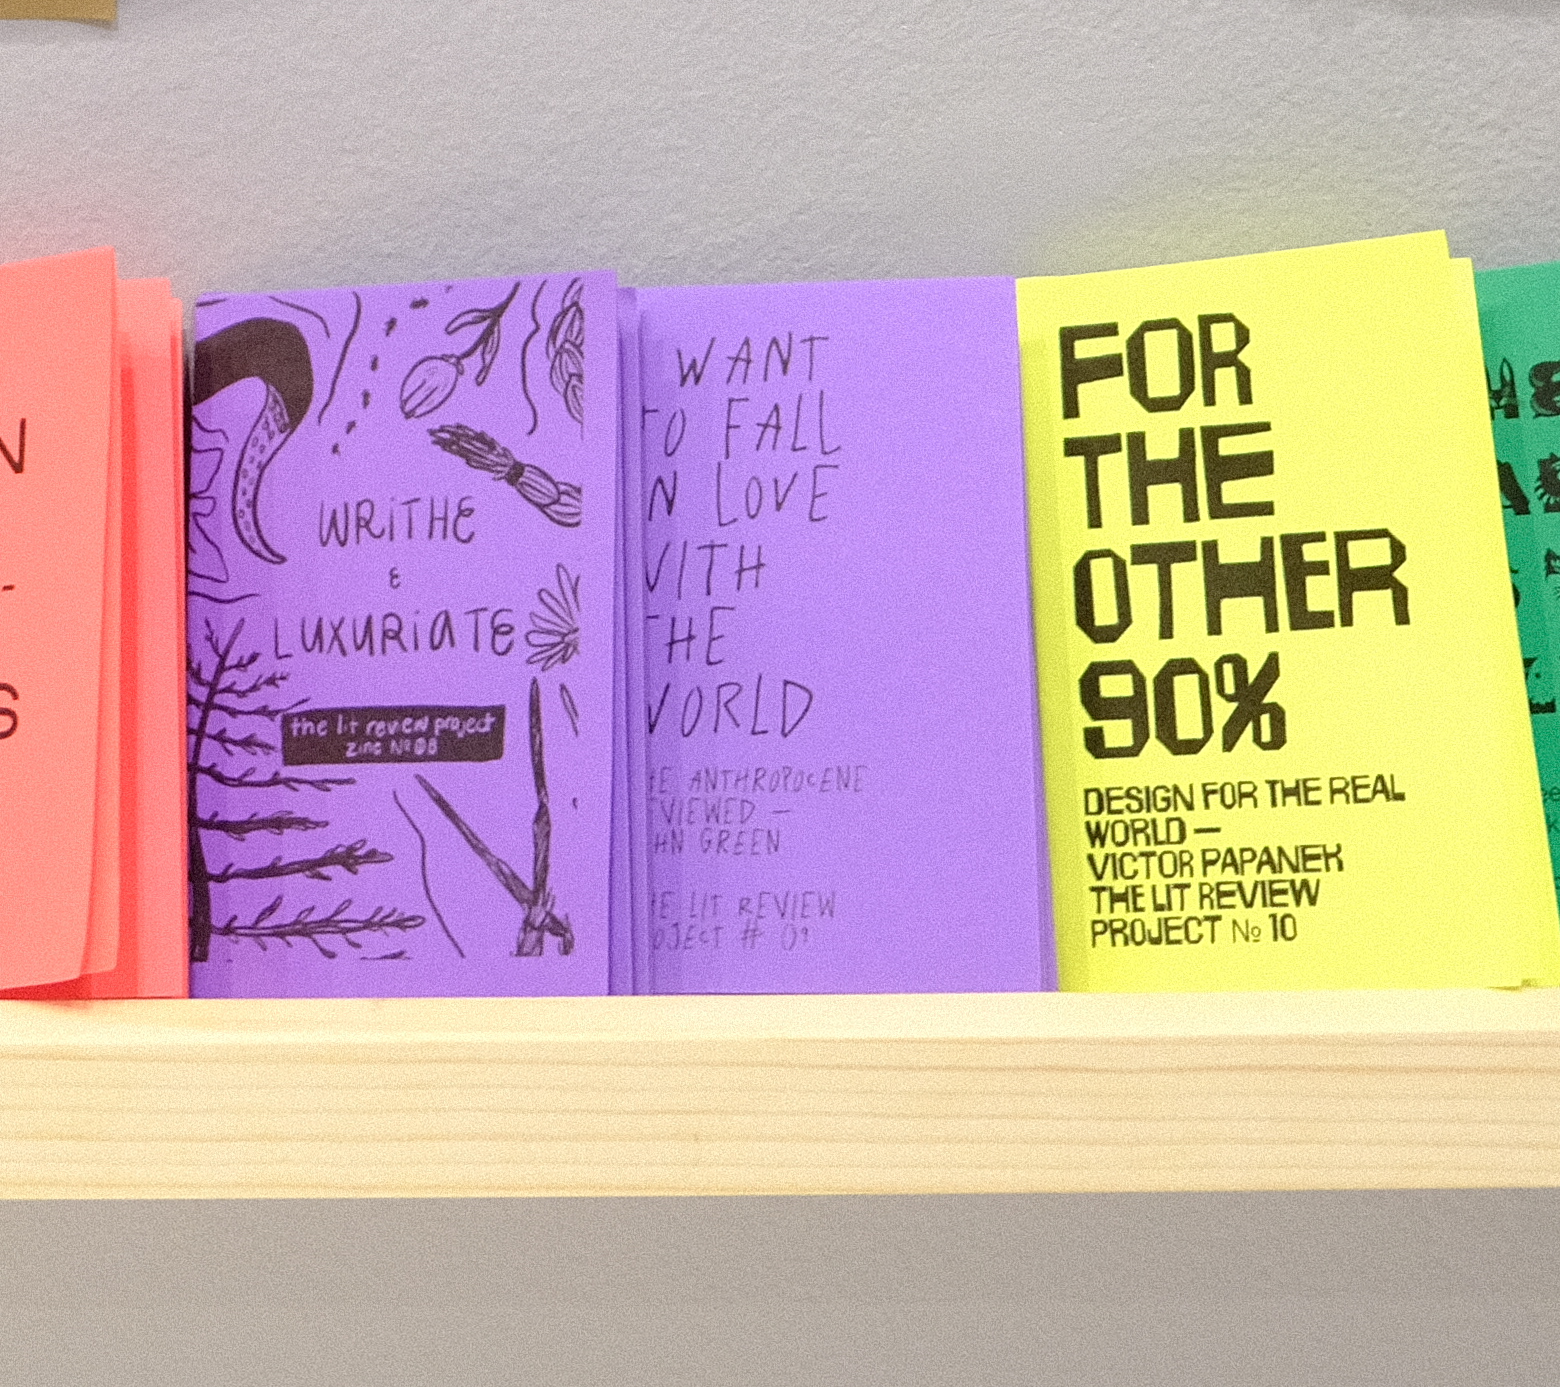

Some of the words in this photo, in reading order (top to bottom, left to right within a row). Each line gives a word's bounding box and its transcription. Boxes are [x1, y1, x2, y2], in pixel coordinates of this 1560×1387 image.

[678, 331, 830, 386] WANT
[1059, 313, 1253, 419] FOR
[725, 391, 842, 459] FALL
[717, 462, 839, 527] LOVE
[1062, 421, 1275, 528] THE
[1073, 528, 1411, 645] OTHER
[1079, 651, 1288, 759] 90%
[1084, 785, 1195, 815] DESIGN
[1202, 781, 1258, 811] FOR
[1266, 778, 1322, 808] THE
[1329, 773, 1406, 803] REAL
